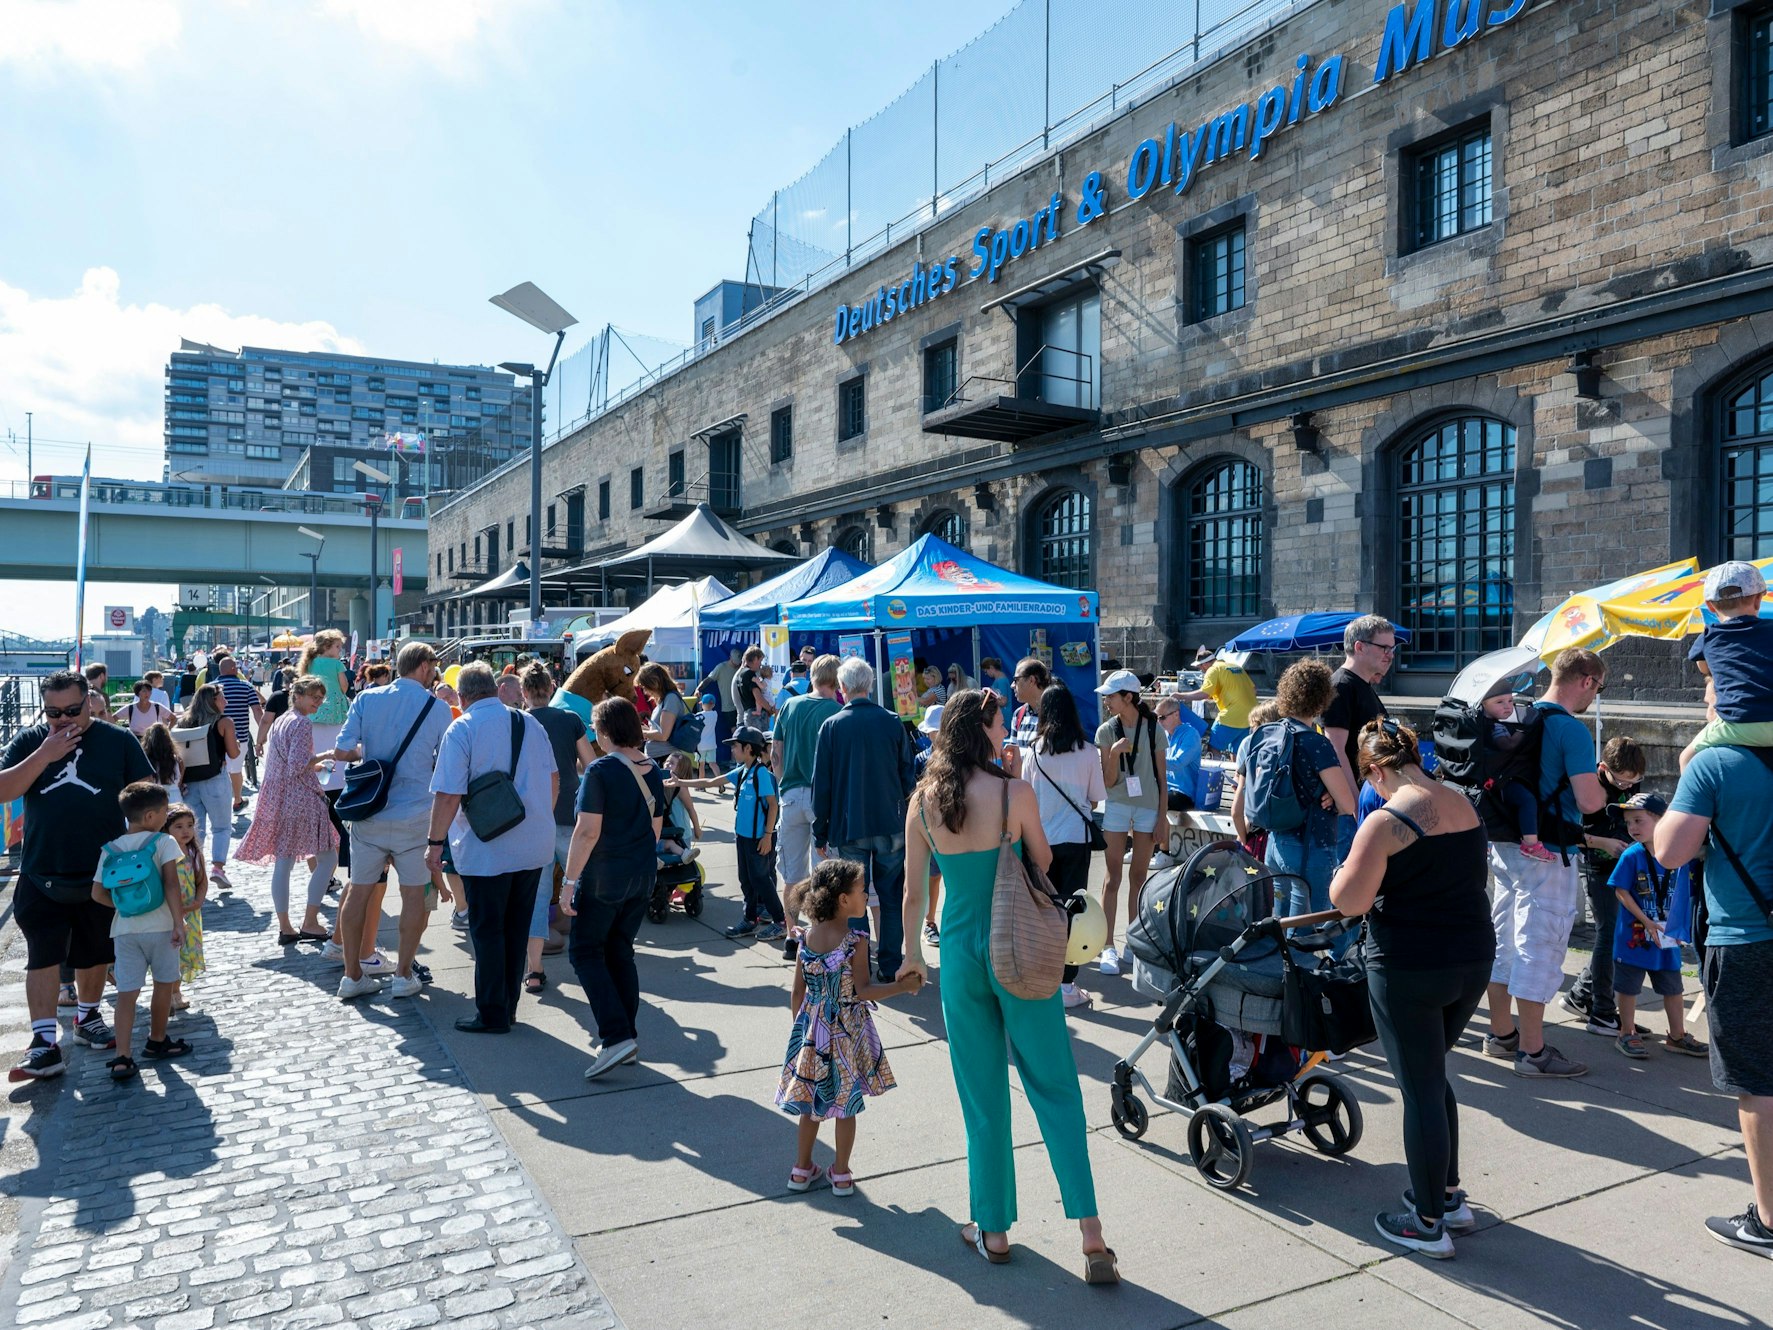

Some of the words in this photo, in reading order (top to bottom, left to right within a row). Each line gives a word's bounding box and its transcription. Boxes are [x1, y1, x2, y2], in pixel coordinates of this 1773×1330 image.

[834, 255, 959, 346] Deutsches
[970, 191, 1062, 284] Sport
[1077, 170, 1105, 226] &
[1127, 53, 1343, 199] Olympia
[187, 589, 200, 601] 14
[917, 605, 937, 617] DAS
[995, 602, 1066, 616] FAMILIENRADIO!
